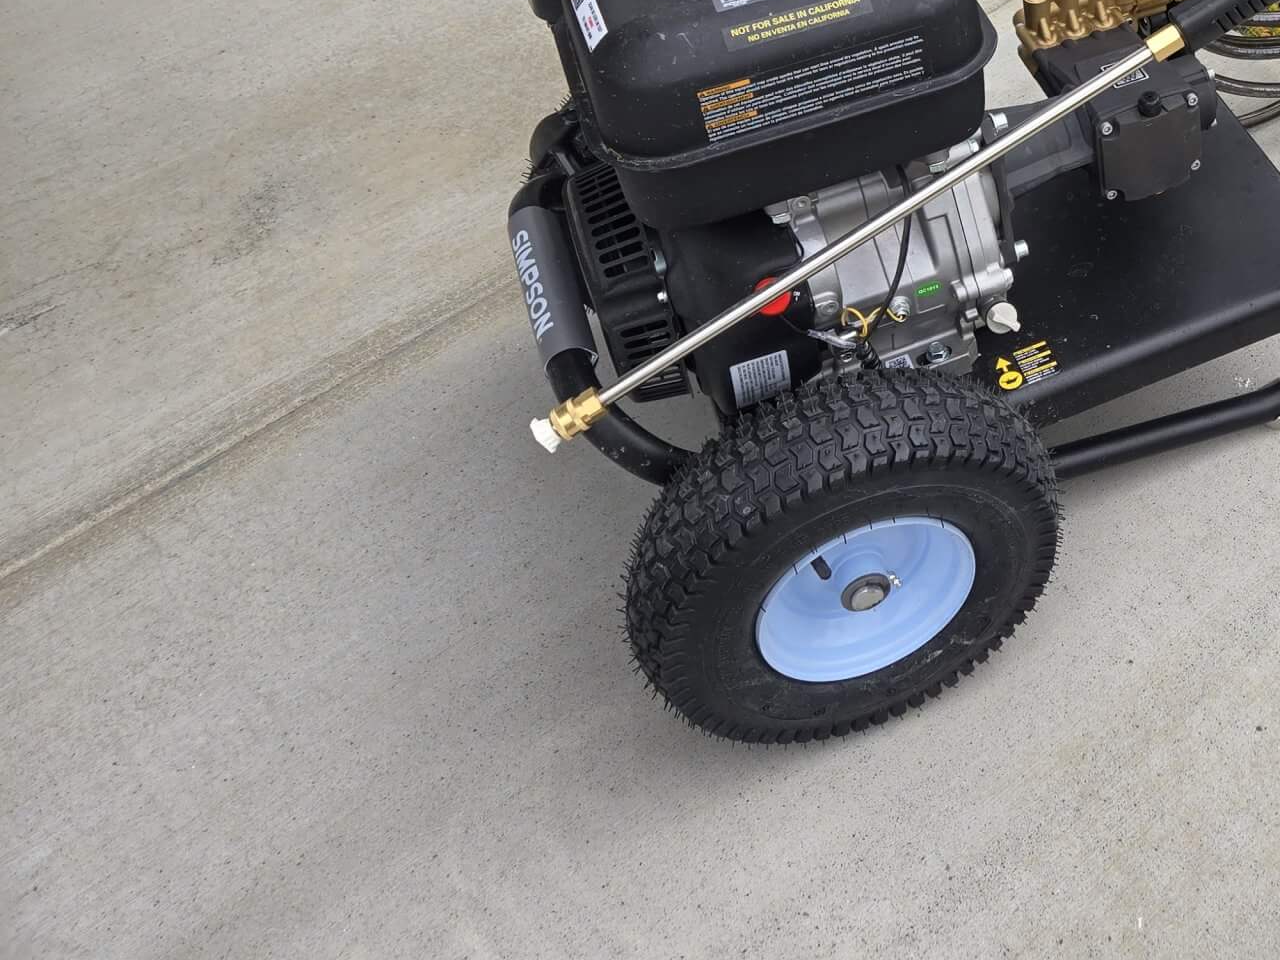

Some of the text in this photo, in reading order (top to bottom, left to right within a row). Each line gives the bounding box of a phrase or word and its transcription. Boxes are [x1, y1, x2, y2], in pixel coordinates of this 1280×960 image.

[730, 24, 751, 37] NOT
[752, 20, 772, 31] FOR
[772, 12, 796, 26] SALE
[797, 9, 807, 19] IN
[748, 9, 851, 43] NO EN VENTA EN CALIFORNIA
[512, 229, 554, 342] SIMPSON
